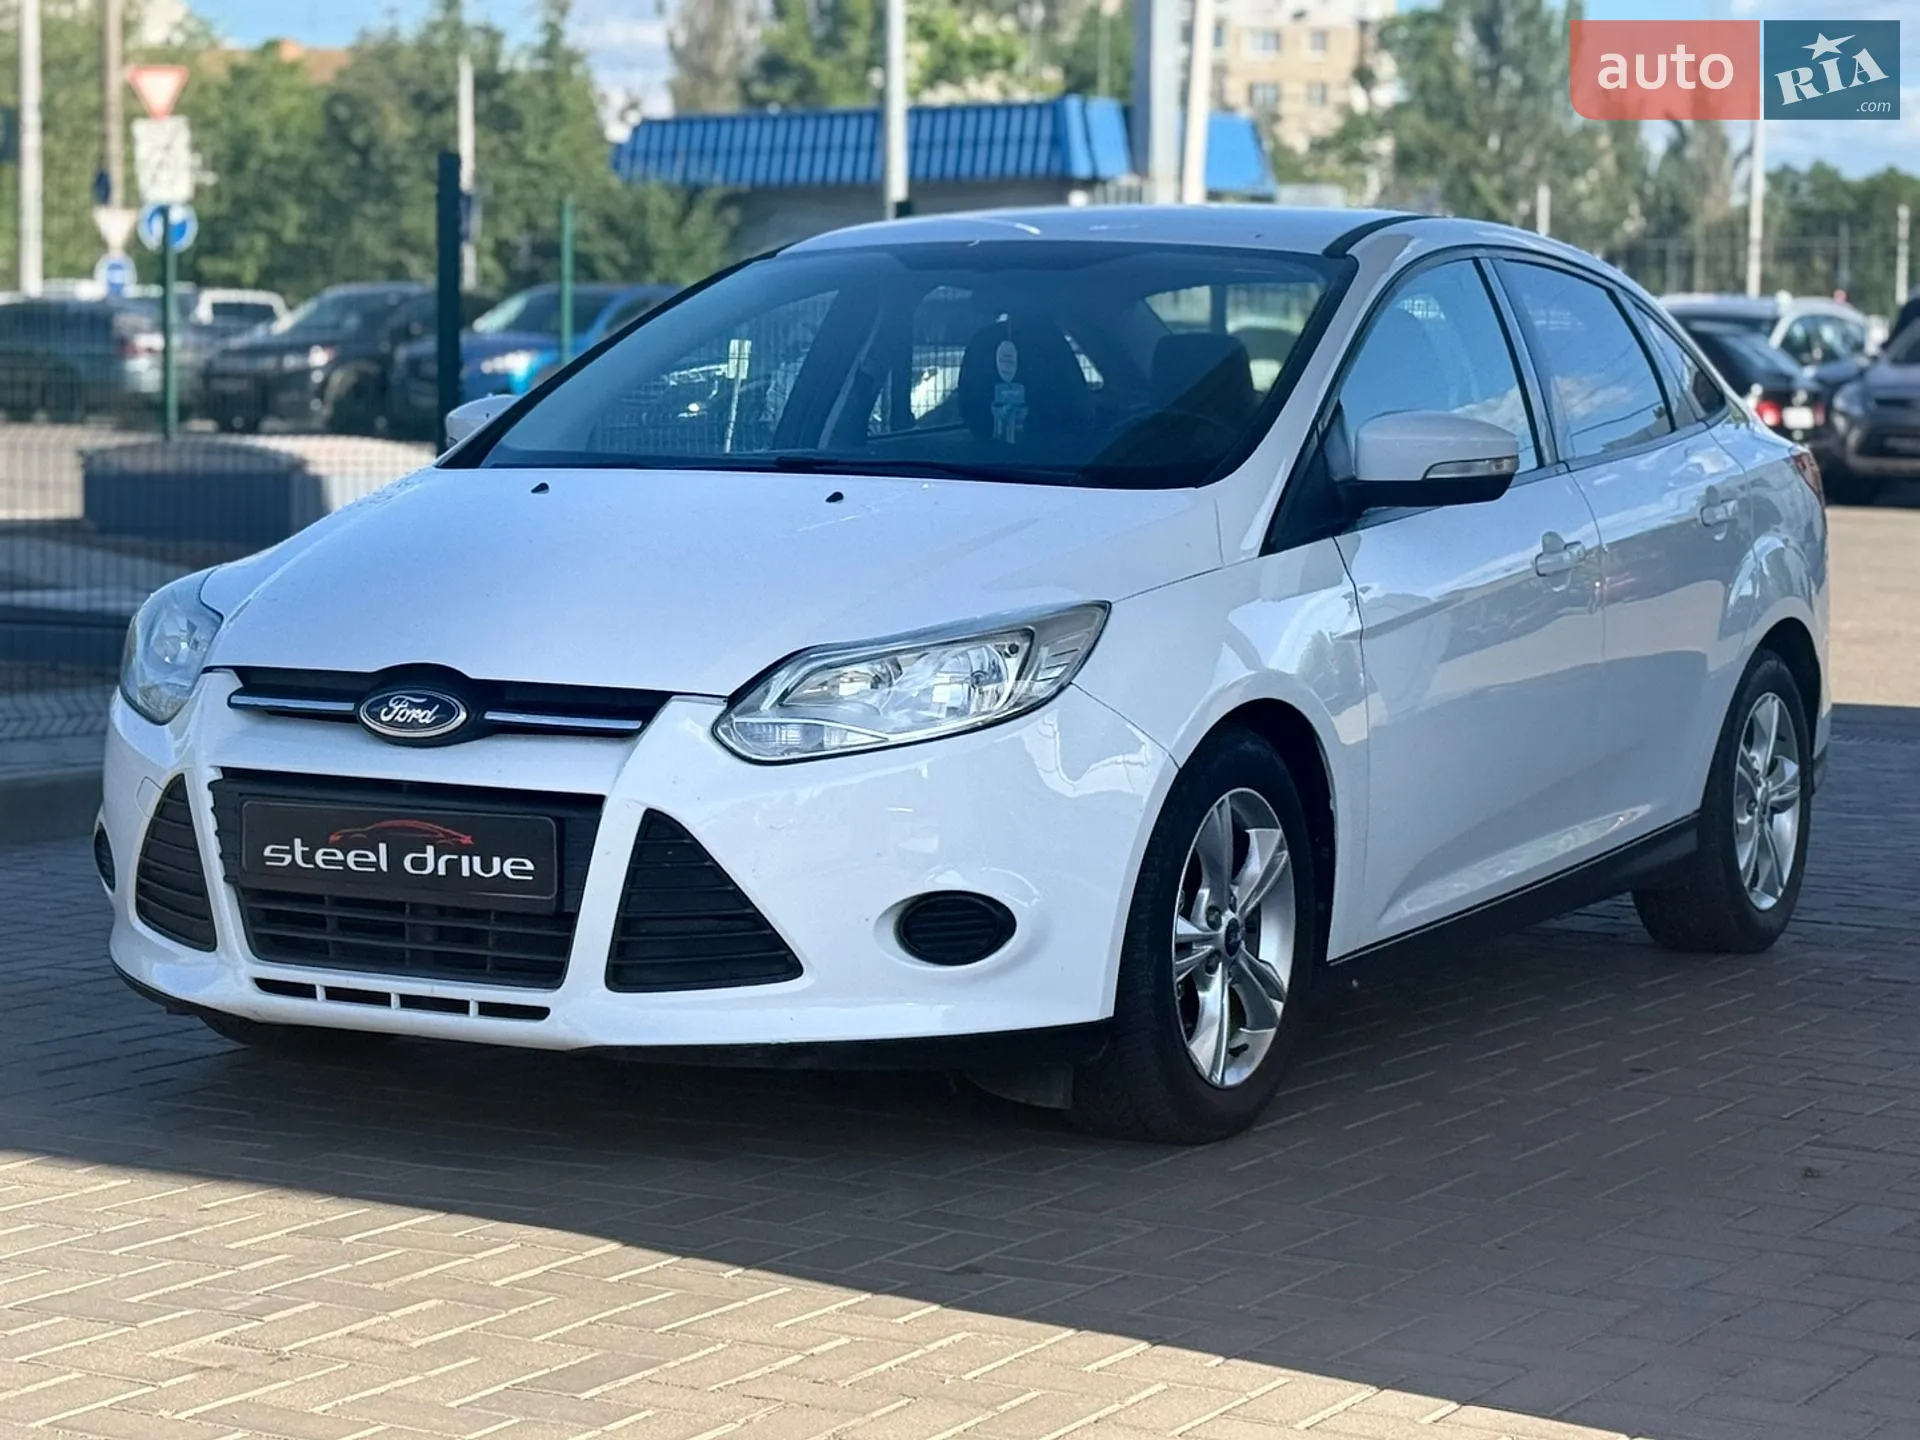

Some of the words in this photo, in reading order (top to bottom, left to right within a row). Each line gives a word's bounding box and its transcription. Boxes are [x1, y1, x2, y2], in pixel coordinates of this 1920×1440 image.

[380, 694, 440, 724] Ford
[263, 837, 388, 873] steel
[403, 844, 535, 881] drive
